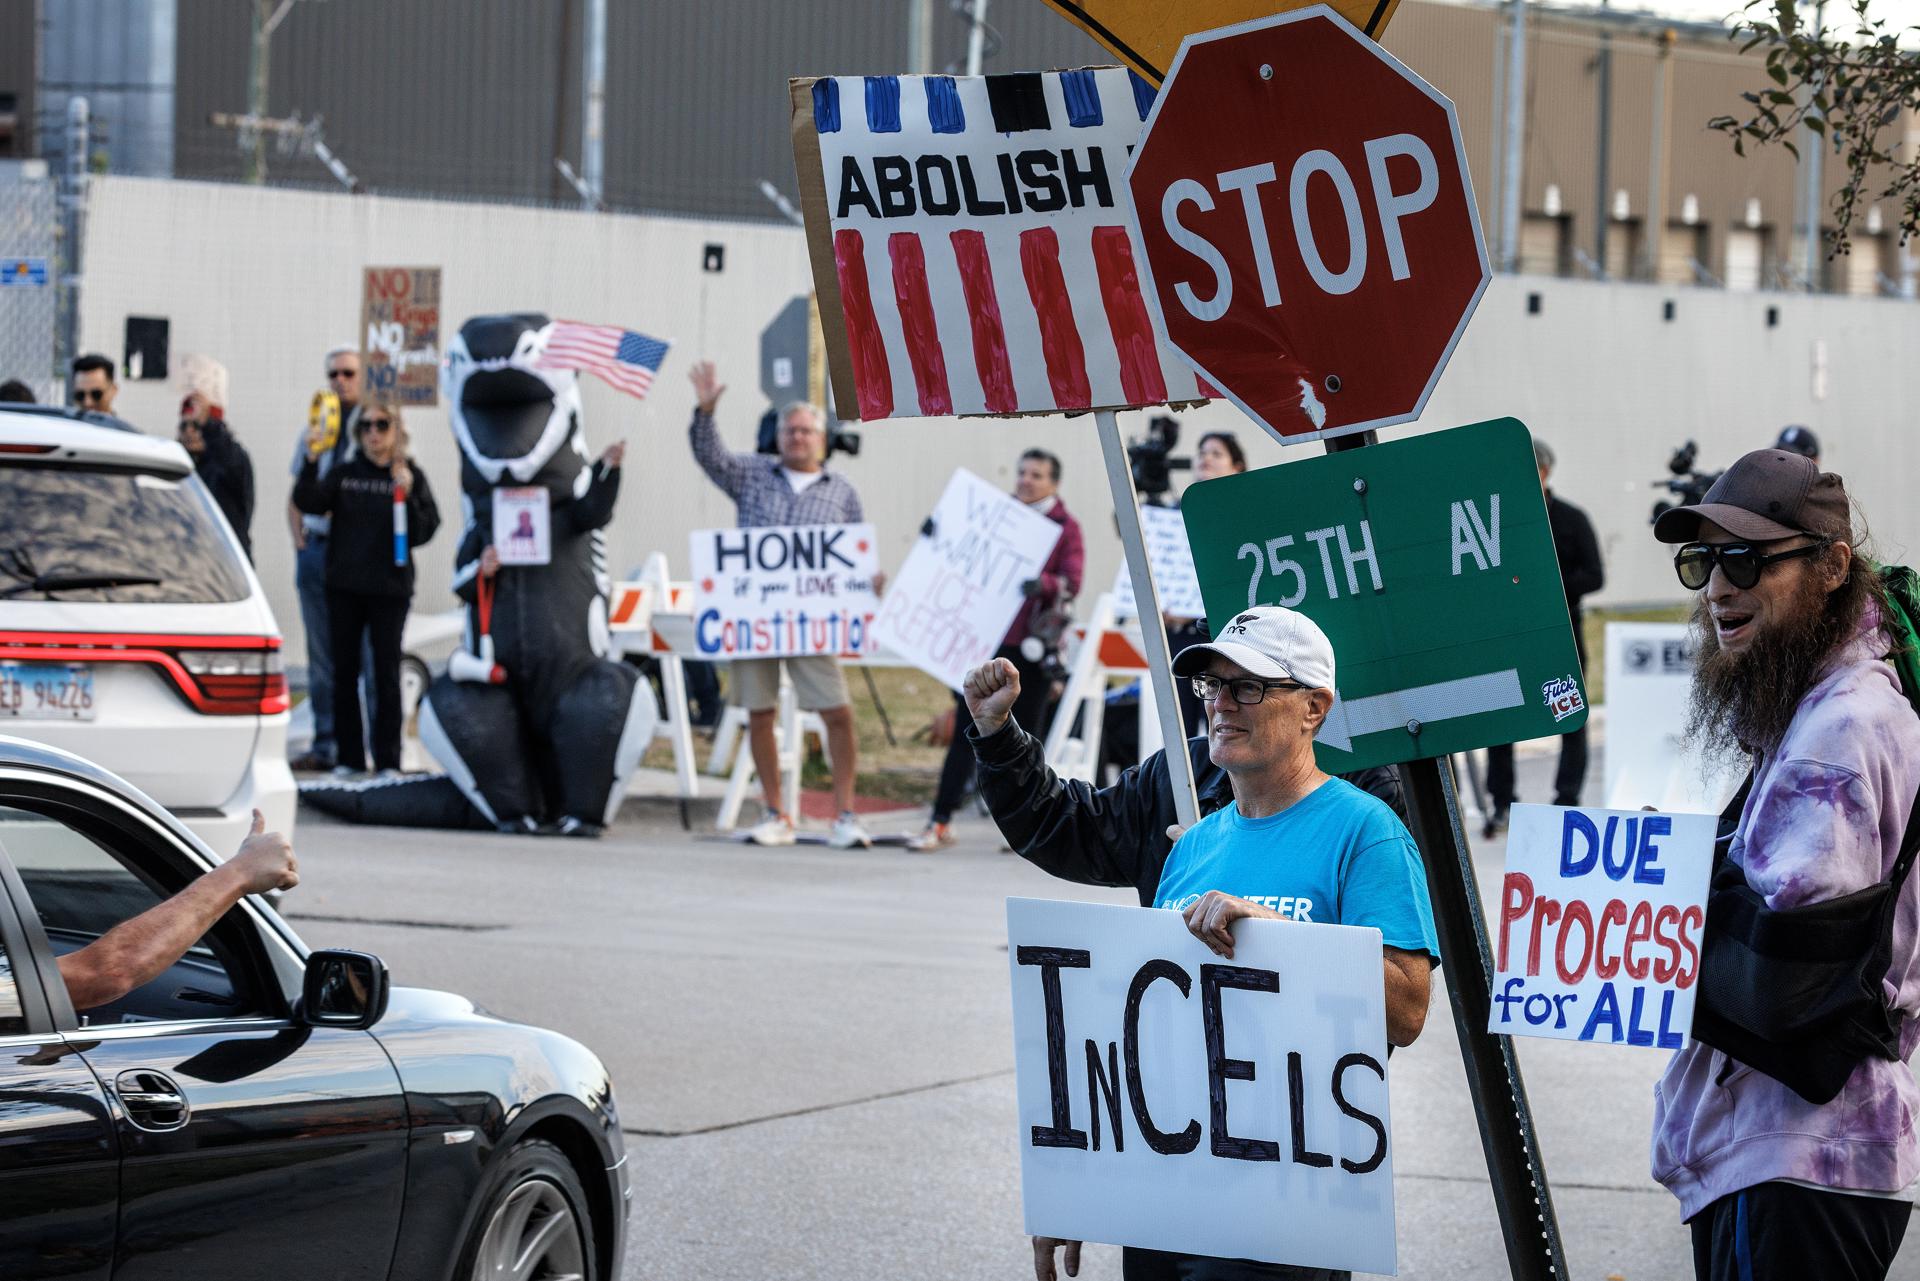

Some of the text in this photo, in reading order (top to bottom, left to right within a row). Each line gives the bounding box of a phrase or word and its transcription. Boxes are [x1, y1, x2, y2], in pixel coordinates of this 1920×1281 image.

[837, 146, 1114, 218] ABOLISH
[1161, 133, 1439, 322] STOP
[368, 323, 404, 353] NO
[967, 484, 1029, 546] WE
[715, 529, 855, 572] HONK
[1237, 493, 1501, 609] 25TH AV
[796, 575, 838, 597] LOVE
[33, 680, 93, 710] 94226
[1542, 675, 1576, 705] Fuck
[1551, 691, 1583, 716] ICE
[1560, 810, 1672, 885] DUE
[1497, 872, 1704, 989] Process
[1494, 978, 1684, 1049] for ALL
